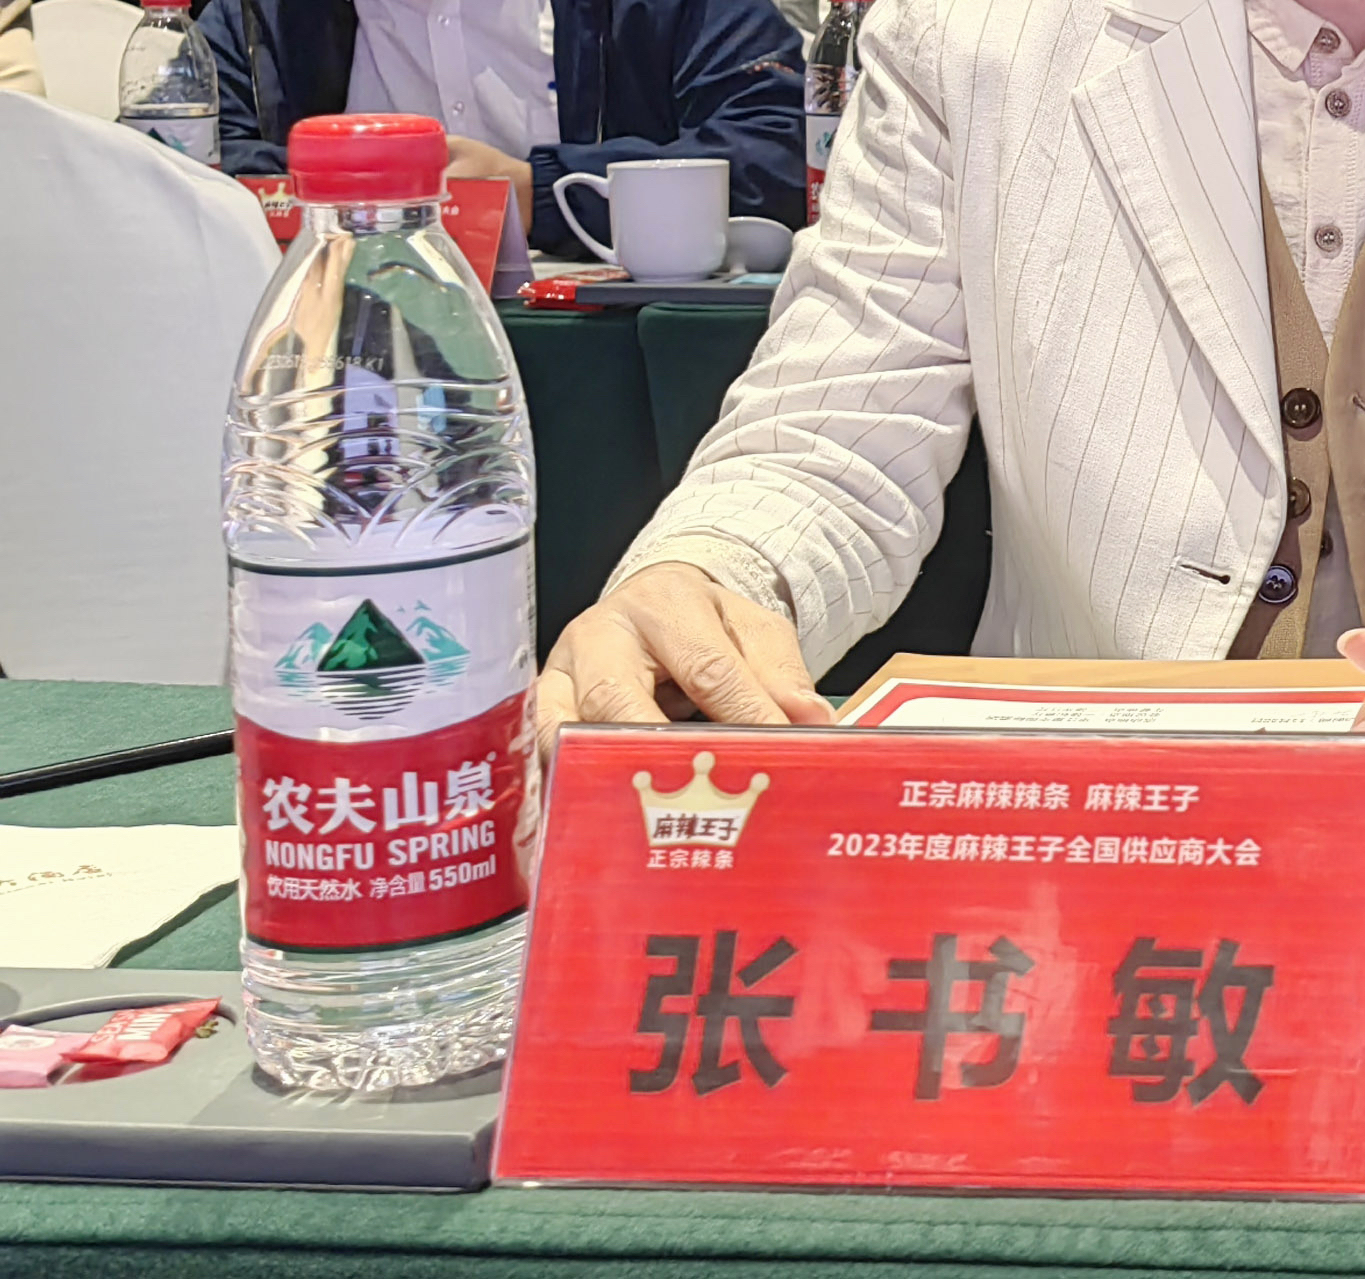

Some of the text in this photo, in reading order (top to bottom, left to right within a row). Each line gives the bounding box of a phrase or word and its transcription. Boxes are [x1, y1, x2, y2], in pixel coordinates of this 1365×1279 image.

[262, 761, 495, 835] 农夫山泉
[900, 781, 1200, 813] 正宗麻辣辣条 麻辣王子
[653, 813, 738, 841] 麻辣王子
[265, 820, 495, 871] NONGFU SPRING
[647, 849, 734, 869] 正宗辣条
[827, 832, 1261, 866] 2023年度麻辣王子全国供应商大会
[266, 874, 362, 903] 饮用天然水
[628, 928, 1274, 1107] 张书敏
